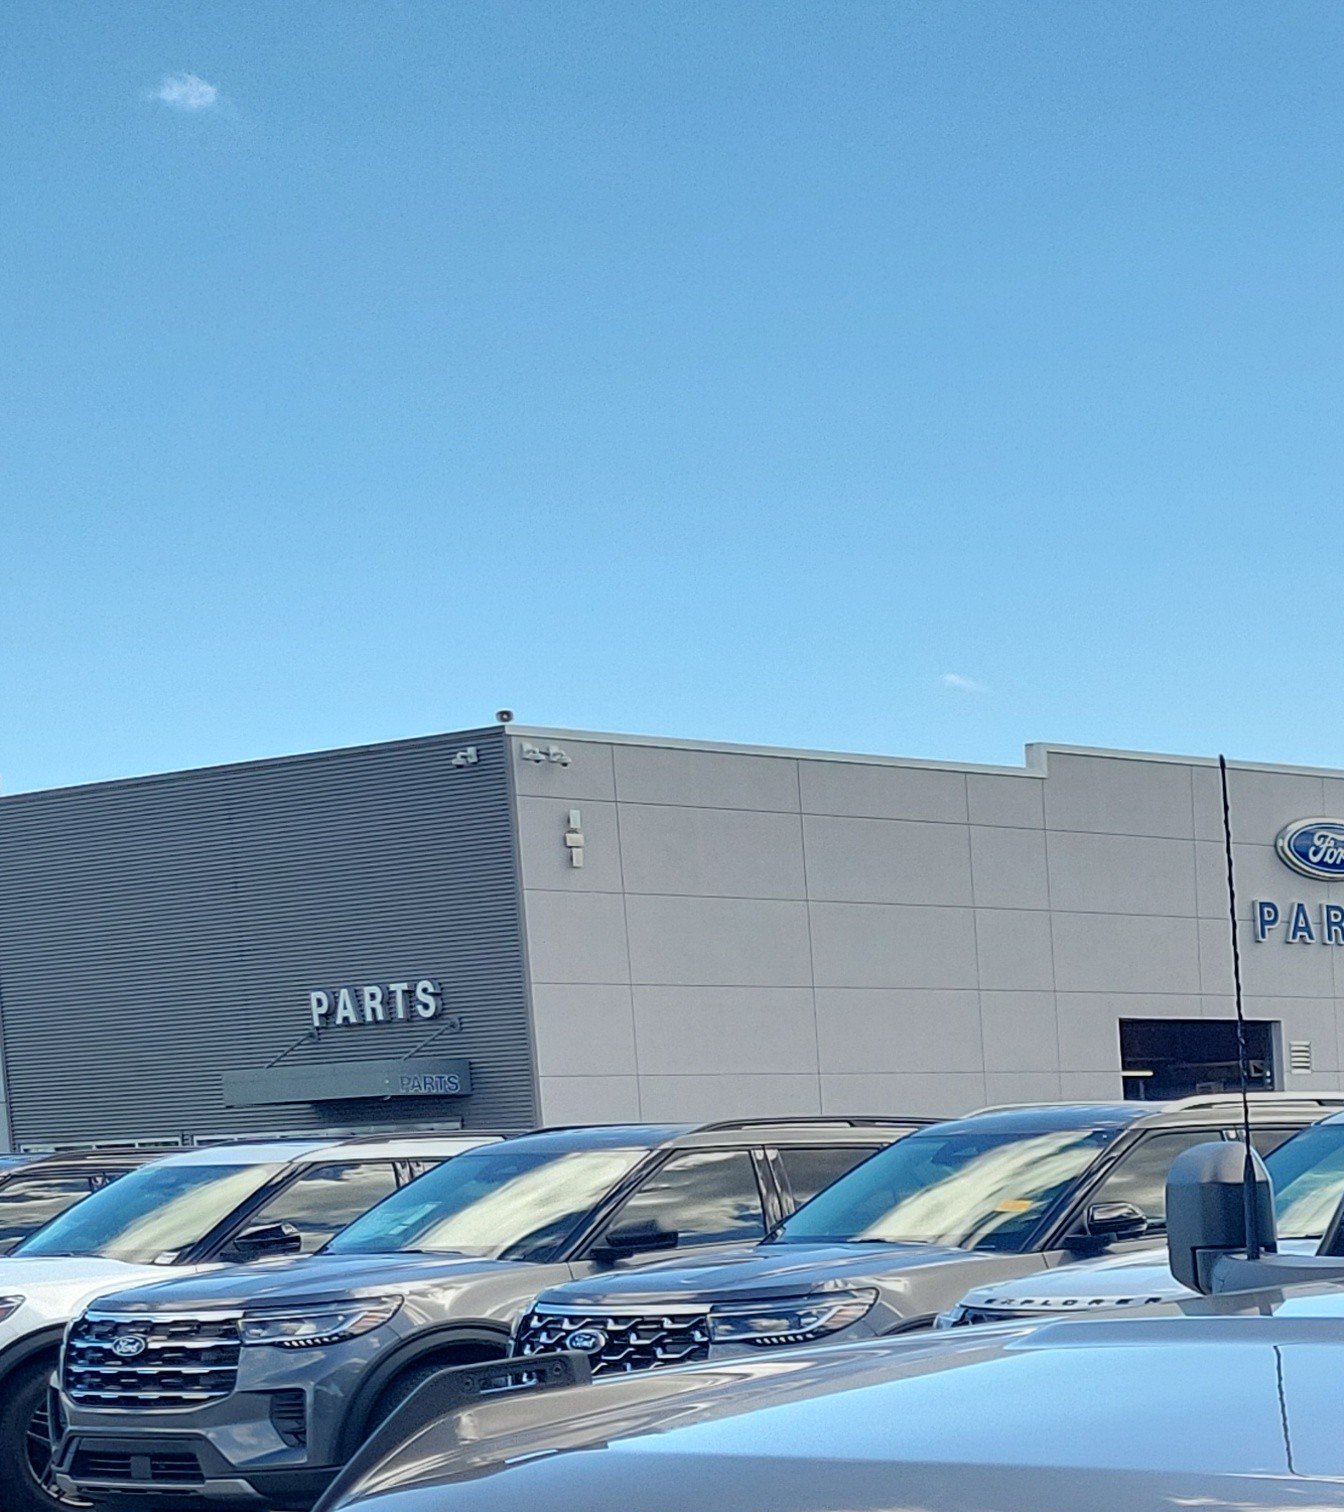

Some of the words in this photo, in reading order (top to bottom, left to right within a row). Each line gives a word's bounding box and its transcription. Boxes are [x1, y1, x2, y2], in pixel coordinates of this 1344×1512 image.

[310, 979, 442, 1028] PARTS
[400, 1074, 461, 1094] PARTS
[984, 1297, 1163, 1306] EXPLORER
